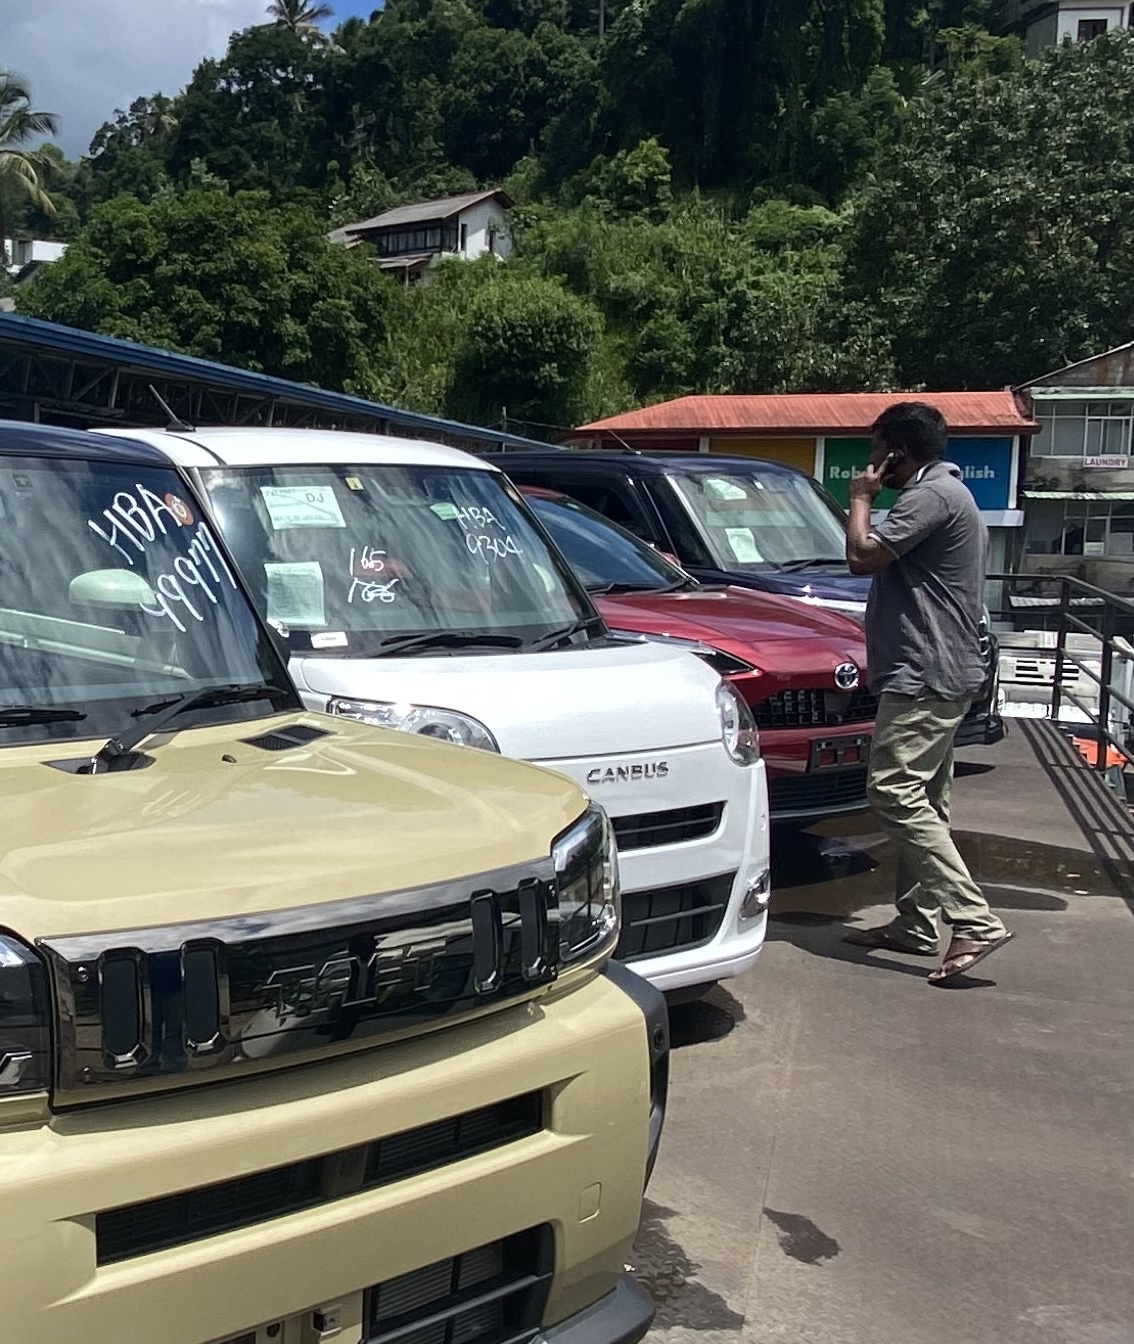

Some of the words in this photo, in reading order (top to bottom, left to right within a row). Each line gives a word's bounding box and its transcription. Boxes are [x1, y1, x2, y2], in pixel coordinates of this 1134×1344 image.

[1085, 457, 1127, 466] LAUNDRY
[88, 484, 182, 565] HBA
[451, 505, 506, 531] HBA
[586, 761, 670, 786] CANBUS
